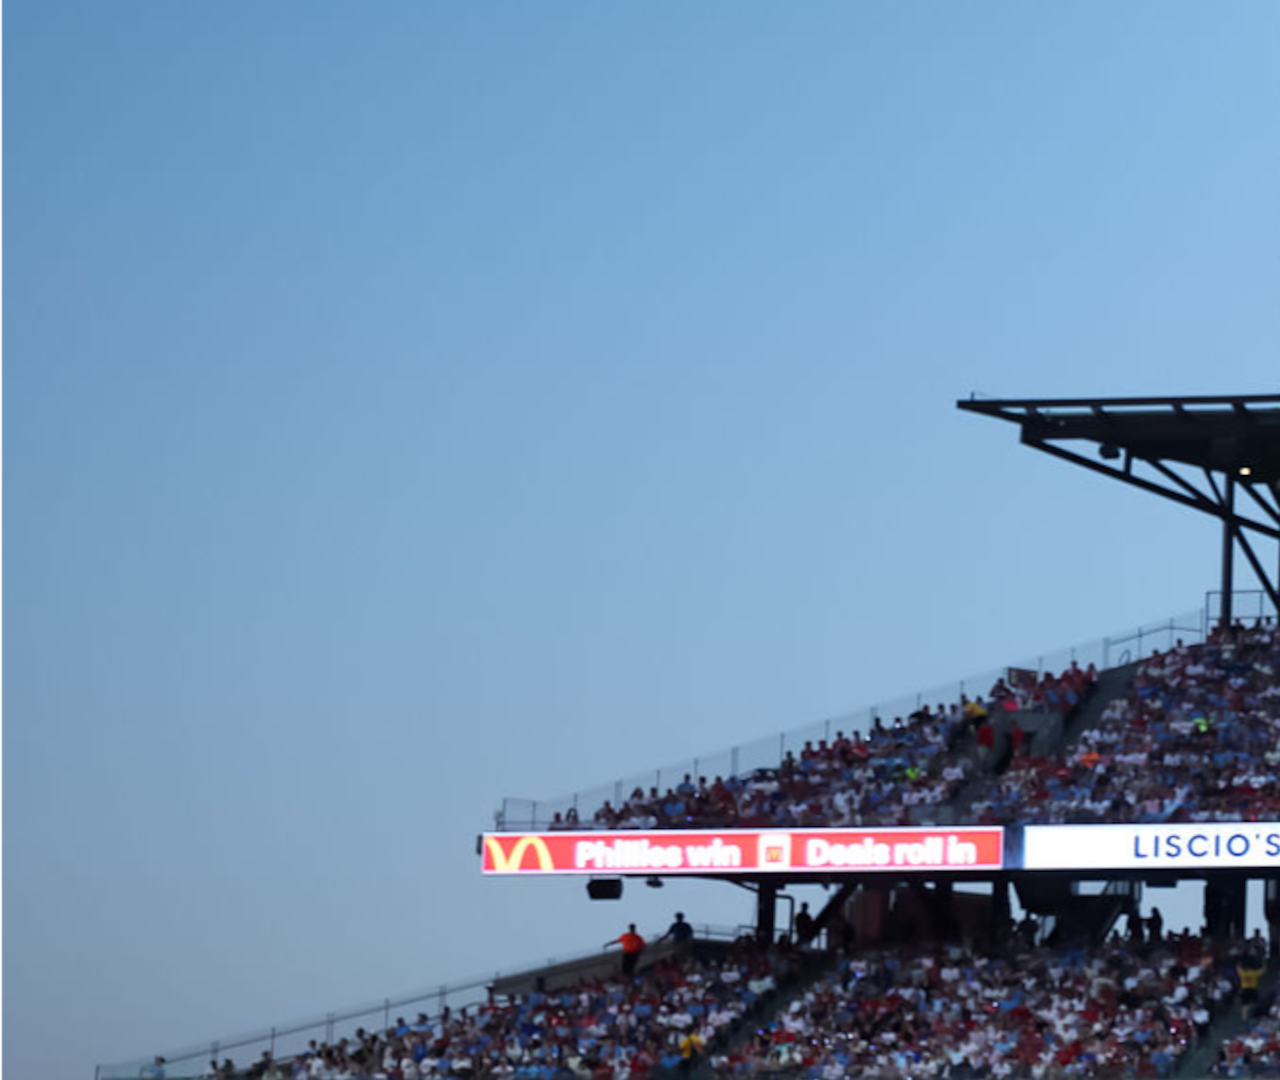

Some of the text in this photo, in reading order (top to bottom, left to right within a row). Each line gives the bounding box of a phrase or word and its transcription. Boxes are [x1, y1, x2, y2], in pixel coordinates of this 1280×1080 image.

[575, 840, 741, 868] Phillies win
[806, 837, 977, 867] Deals roll in
